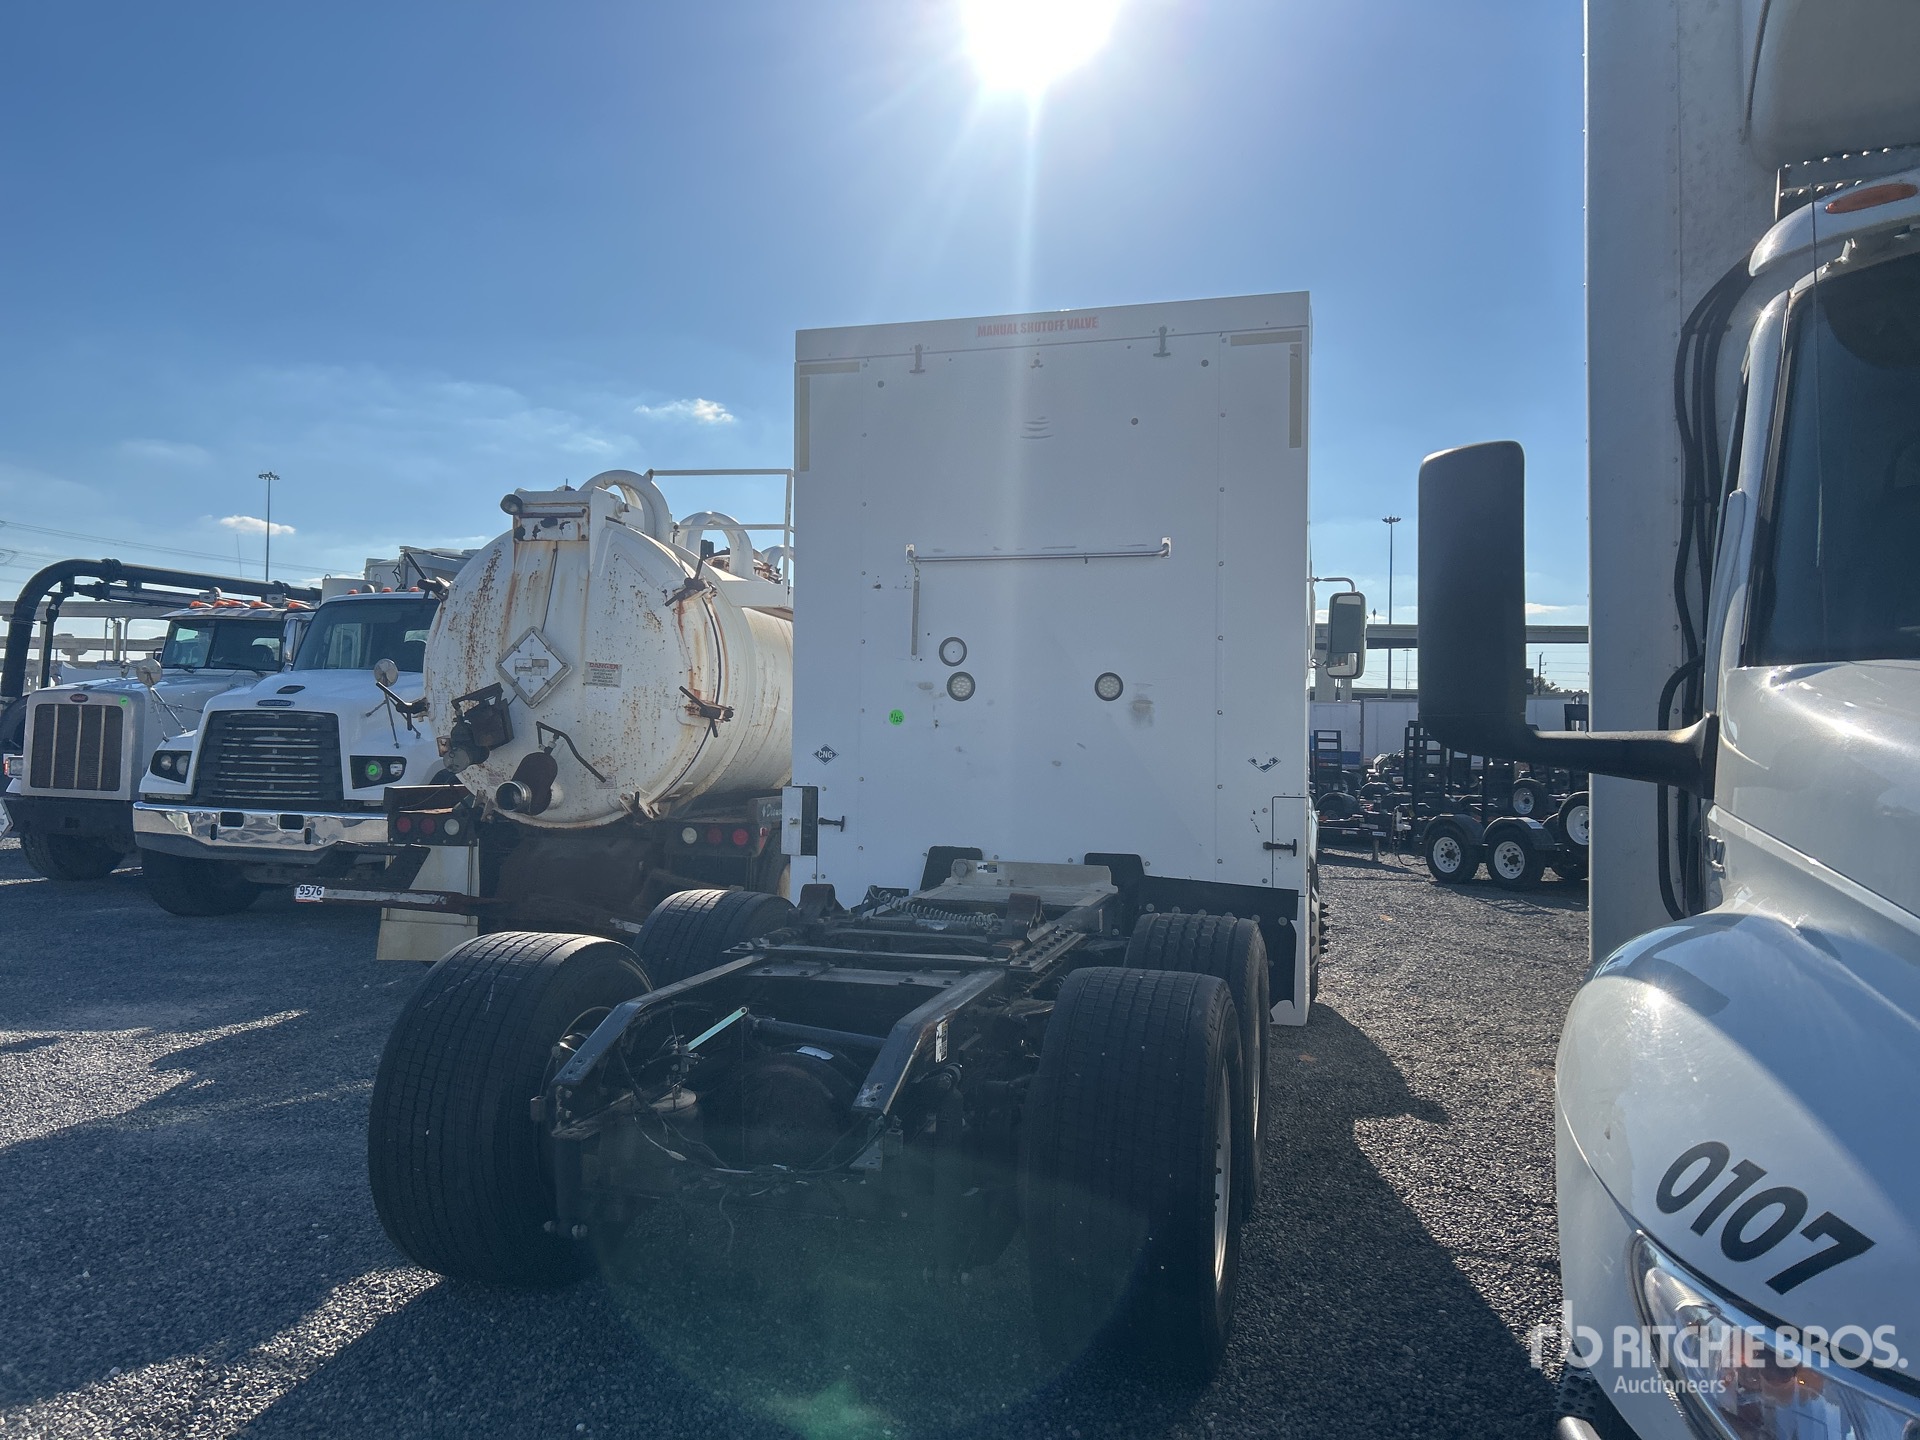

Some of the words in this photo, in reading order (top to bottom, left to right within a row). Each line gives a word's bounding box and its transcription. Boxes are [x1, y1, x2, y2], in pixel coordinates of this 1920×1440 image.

[977, 322, 1018, 337] MANUAL
[1020, 320, 1065, 334] SHUTOFF
[1067, 318, 1098, 330] VALVE
[590, 662, 619, 670] DANGER
[818, 750, 833, 759] CNG
[299, 886, 322, 895] 9576
[1656, 1141, 1877, 1295] 0107
